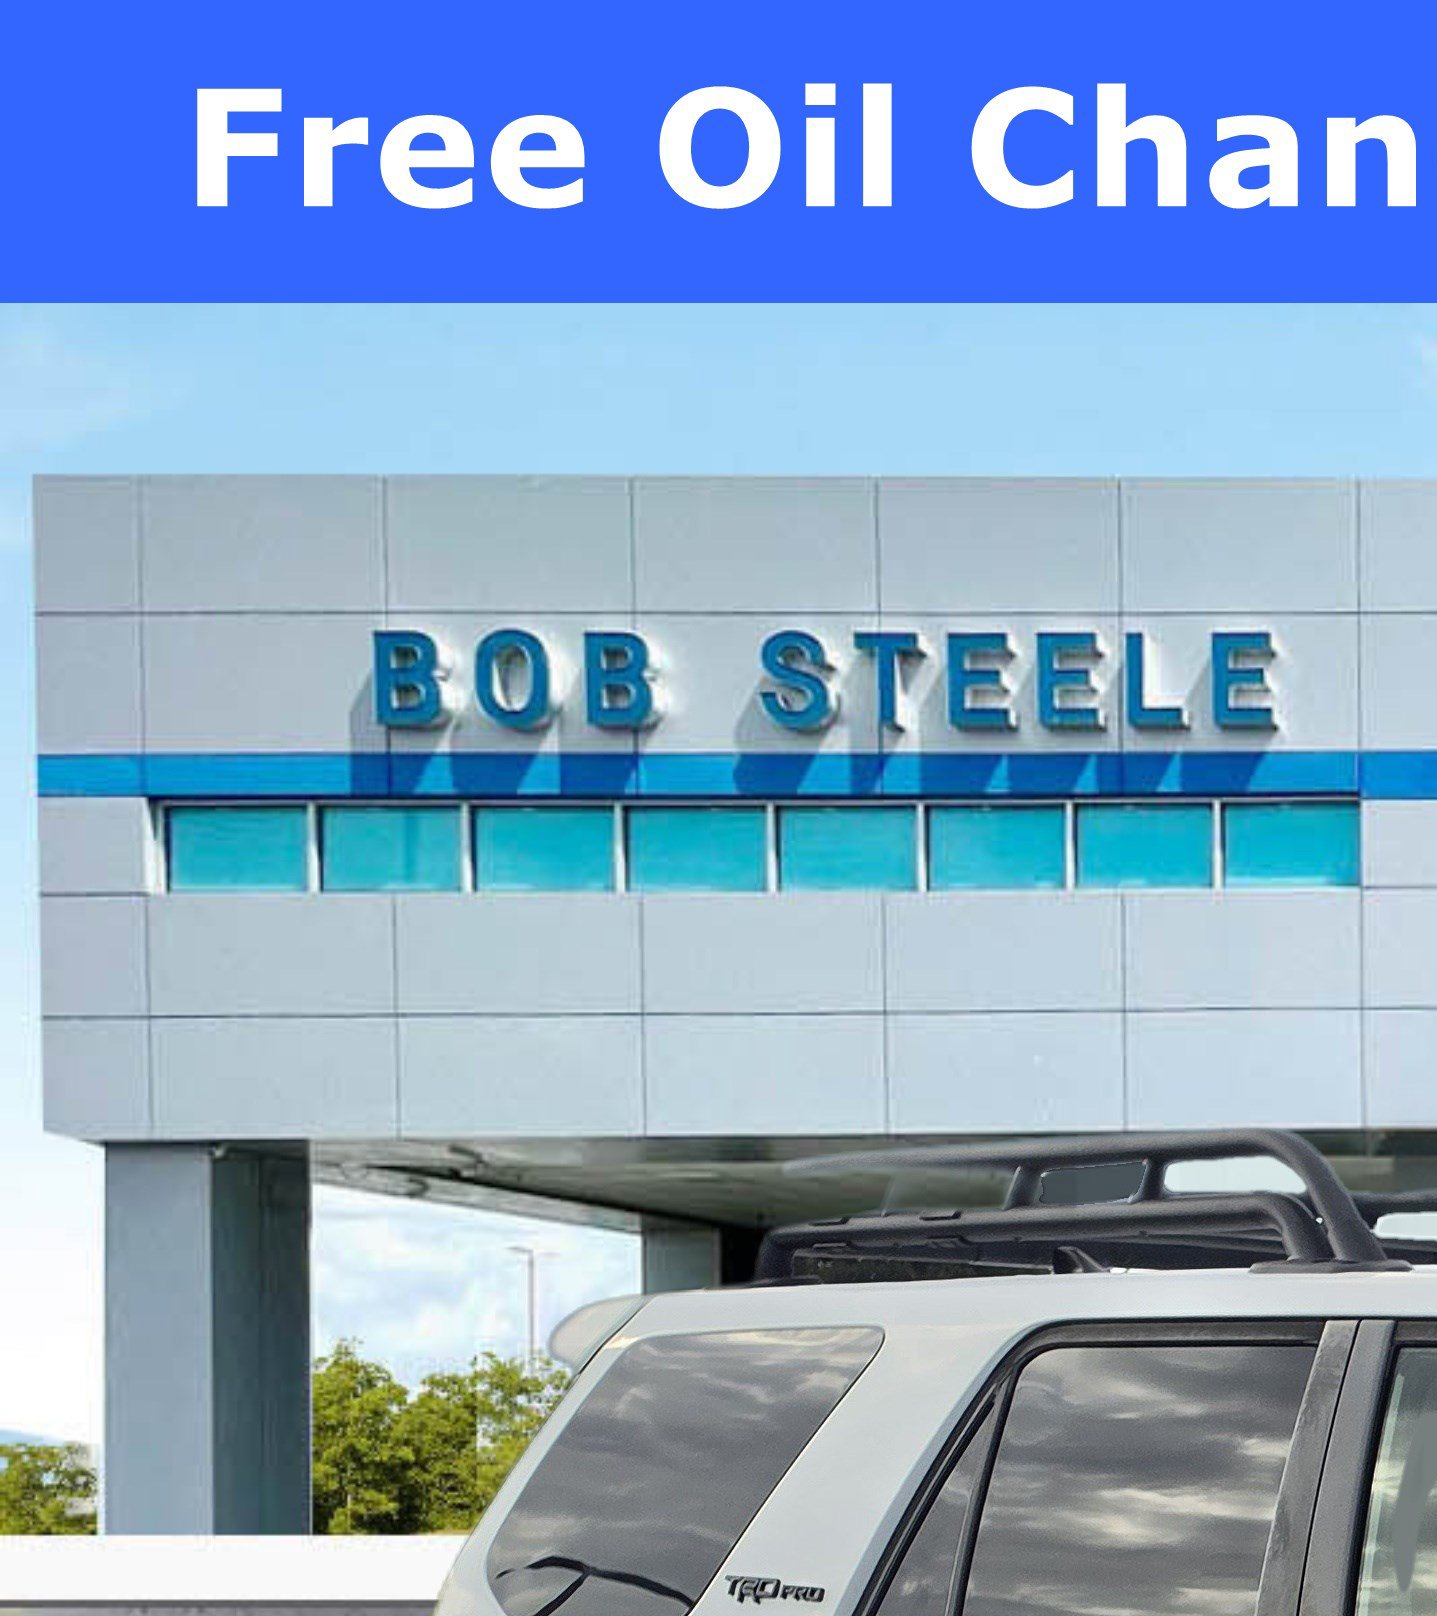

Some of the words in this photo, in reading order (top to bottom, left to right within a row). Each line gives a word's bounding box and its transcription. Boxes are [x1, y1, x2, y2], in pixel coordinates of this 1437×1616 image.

[371, 629, 660, 730] BOB
[759, 629, 1279, 732] STEELE
[724, 1574, 781, 1604] TRD
[781, 1584, 826, 1603] PRO
